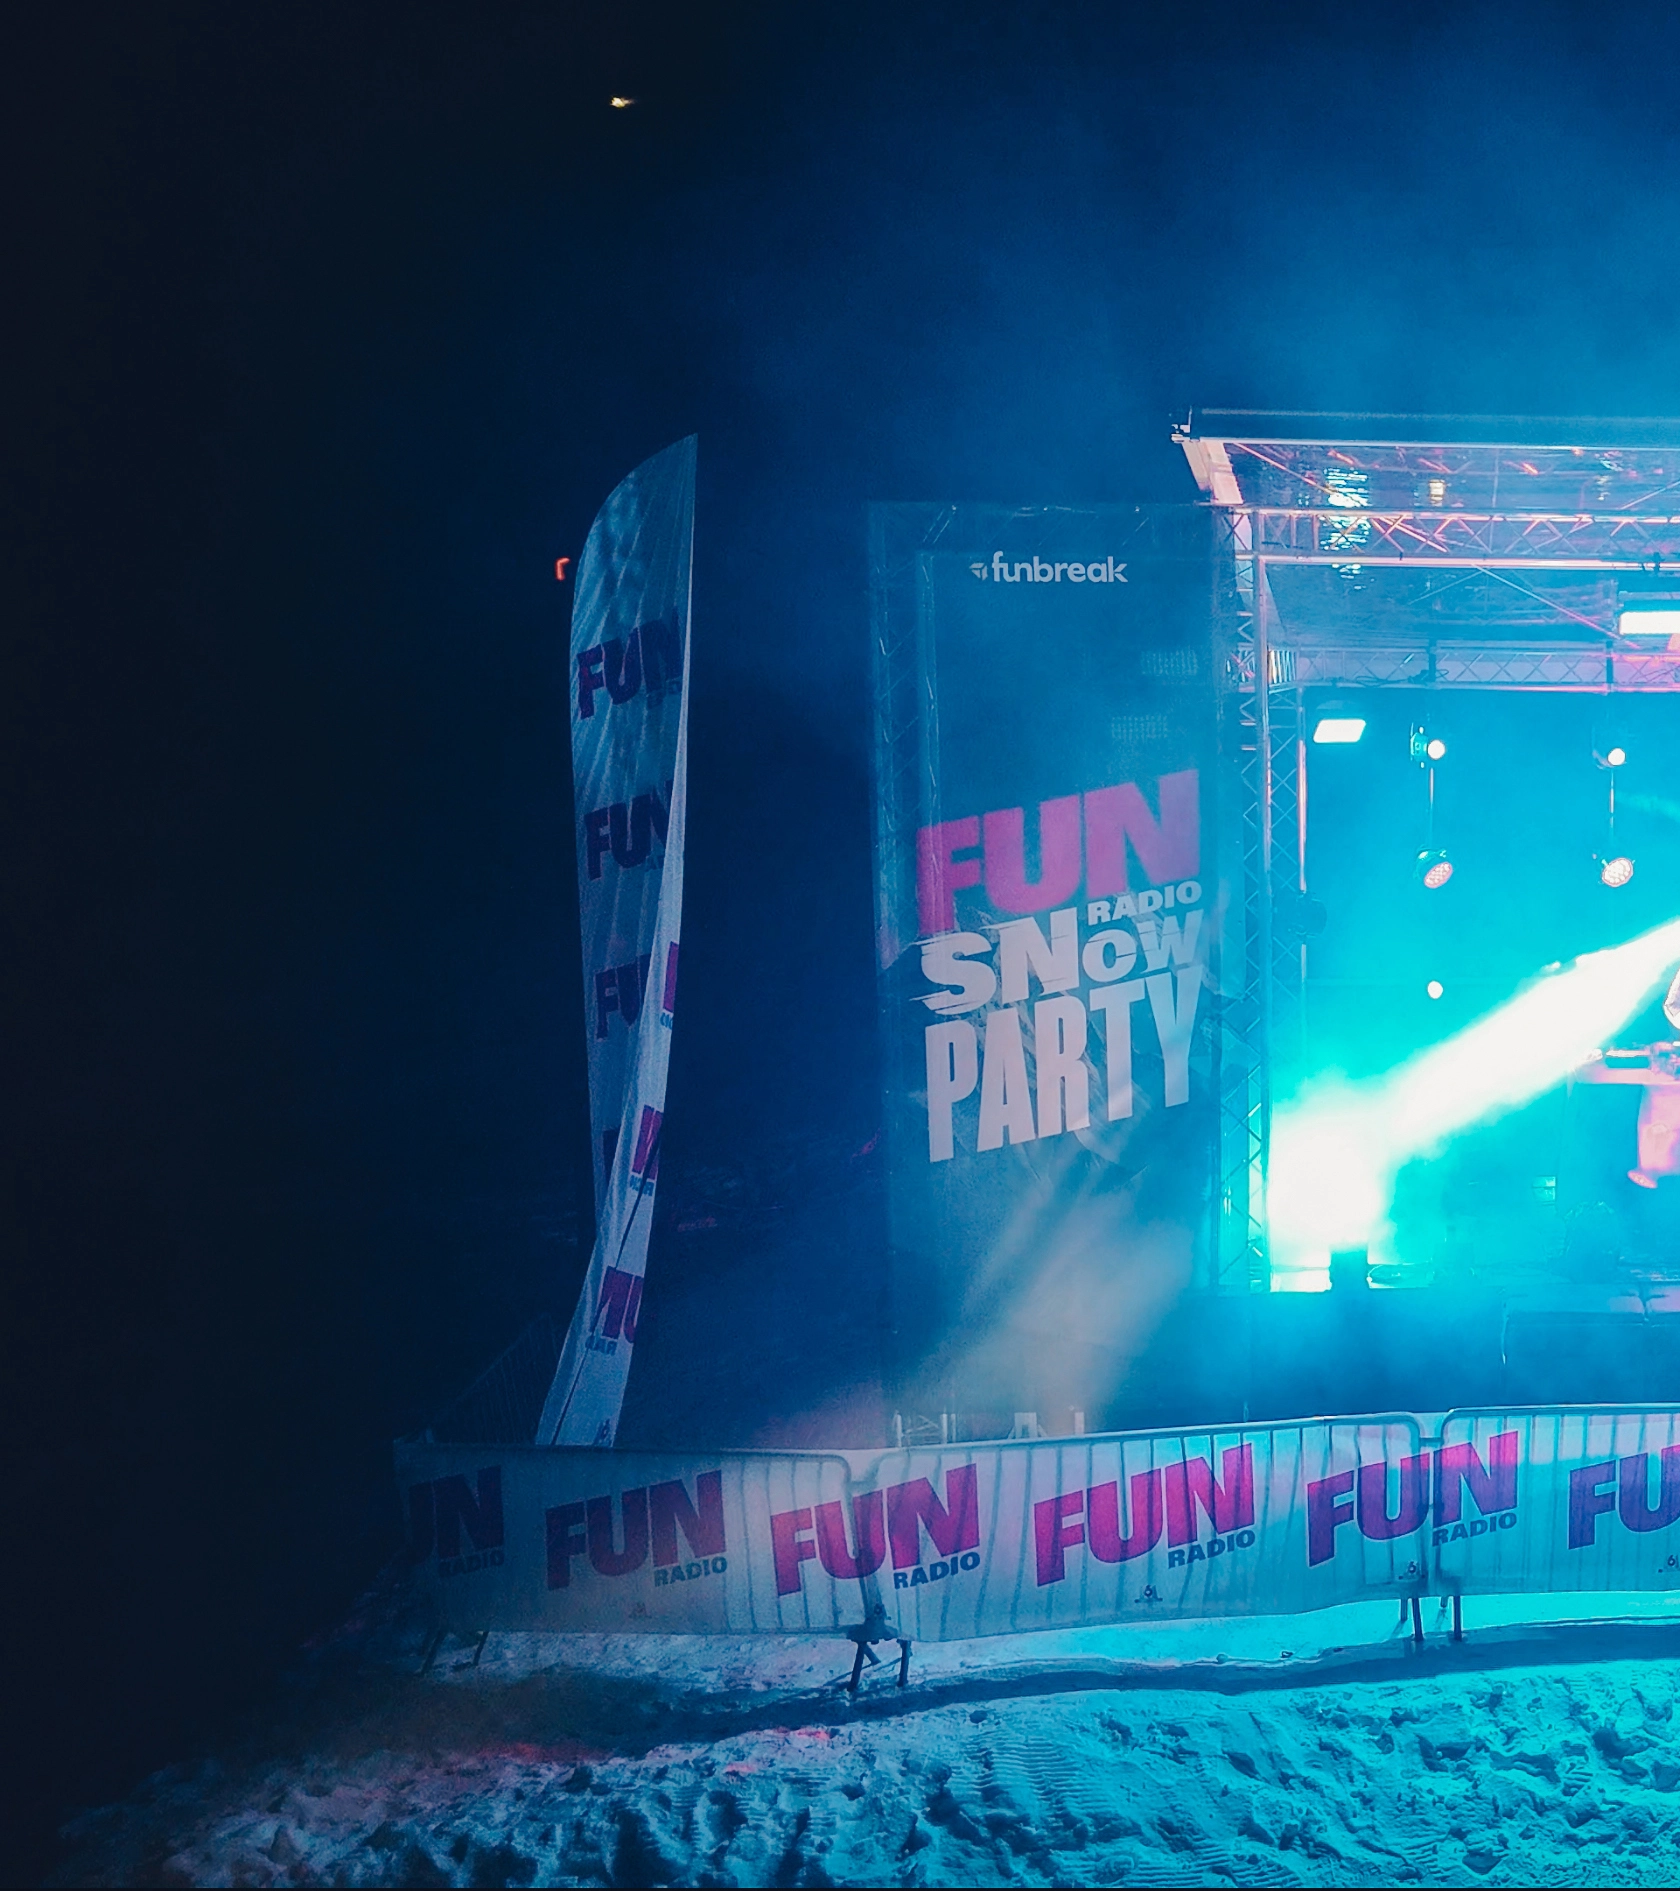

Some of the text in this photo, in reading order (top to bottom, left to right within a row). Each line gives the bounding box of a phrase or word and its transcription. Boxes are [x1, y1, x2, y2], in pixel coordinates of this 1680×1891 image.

[992, 550, 1128, 585] funbreak
[577, 605, 682, 720] FUN
[915, 769, 1200, 935] FUN
[1087, 880, 1202, 927] RADIO
[595, 953, 652, 1039] FU
[924, 966, 1201, 1163] PARTY
[388, 1465, 505, 1567] UN
[545, 1470, 727, 1592] FUN
[771, 1463, 980, 1596] FUN
[1034, 1443, 1255, 1587] FUN
[1167, 1529, 1257, 1569] RADIO
[1307, 1430, 1518, 1567] FUN
[1432, 1511, 1518, 1547] RADIO
[654, 1556, 728, 1588] RADIO
[893, 1551, 981, 1591] RADIO
